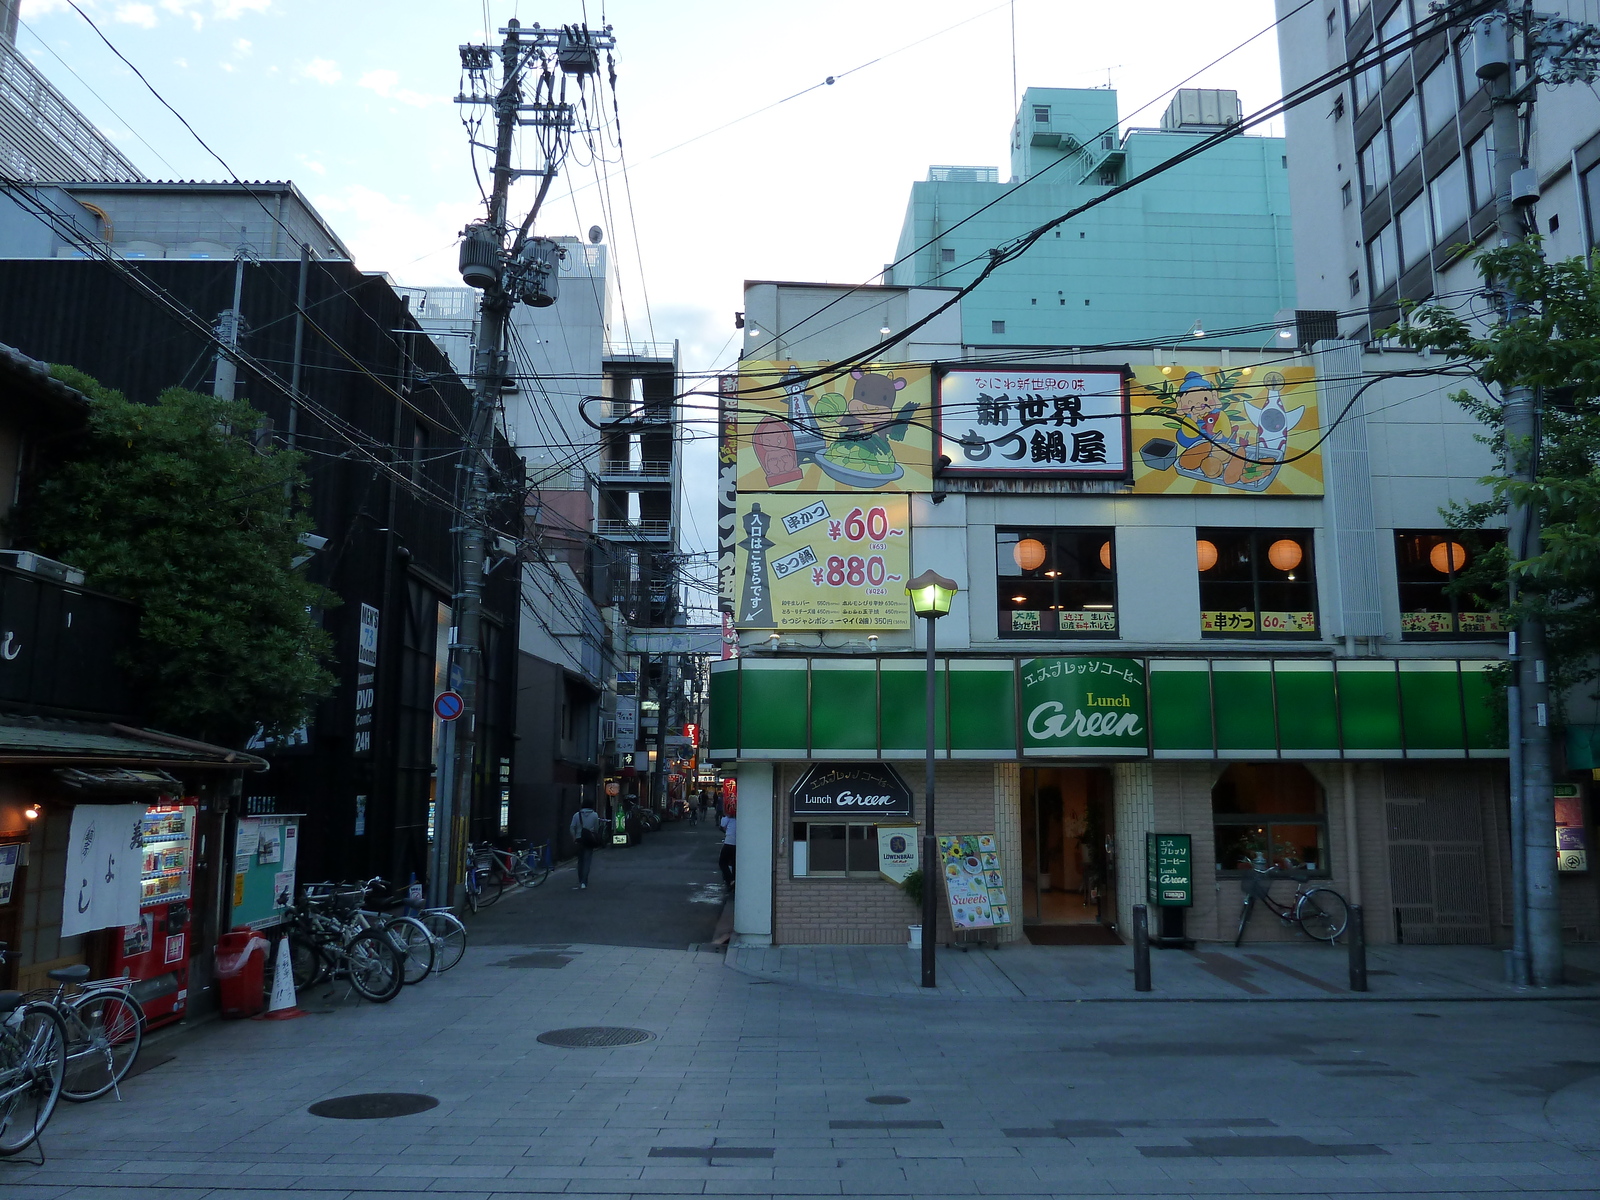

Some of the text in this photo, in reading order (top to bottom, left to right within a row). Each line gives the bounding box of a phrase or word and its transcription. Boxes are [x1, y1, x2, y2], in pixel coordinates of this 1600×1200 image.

[975, 377, 1086, 391] なにわ新世界の味
[977, 392, 1085, 427] 新世界
[961, 428, 1107, 464] もつ鍋屋
[786, 505, 825, 530] 串かつ
[750, 514, 763, 608] 入口はこちらです
[775, 549, 815, 575] もつ鍋
[361, 604, 379, 628] MEN'S
[1013, 620, 1040, 631] 新世界
[1015, 612, 1037, 620] 大阪
[1064, 613, 1085, 621] 近江
[1214, 612, 1253, 630] 串かつ
[364, 628, 374, 647] 73
[1024, 659, 1144, 688] エスプレッソコーヒー
[356, 688, 374, 711] DVD
[1086, 692, 1131, 708] Lunch
[355, 713, 372, 727] Comic
[1026, 700, 1144, 740] Green
[355, 731, 371, 752] 24H
[805, 790, 897, 806] Lunch Green
[1159, 874, 1189, 884] Green
[952, 894, 987, 906] Sweets
